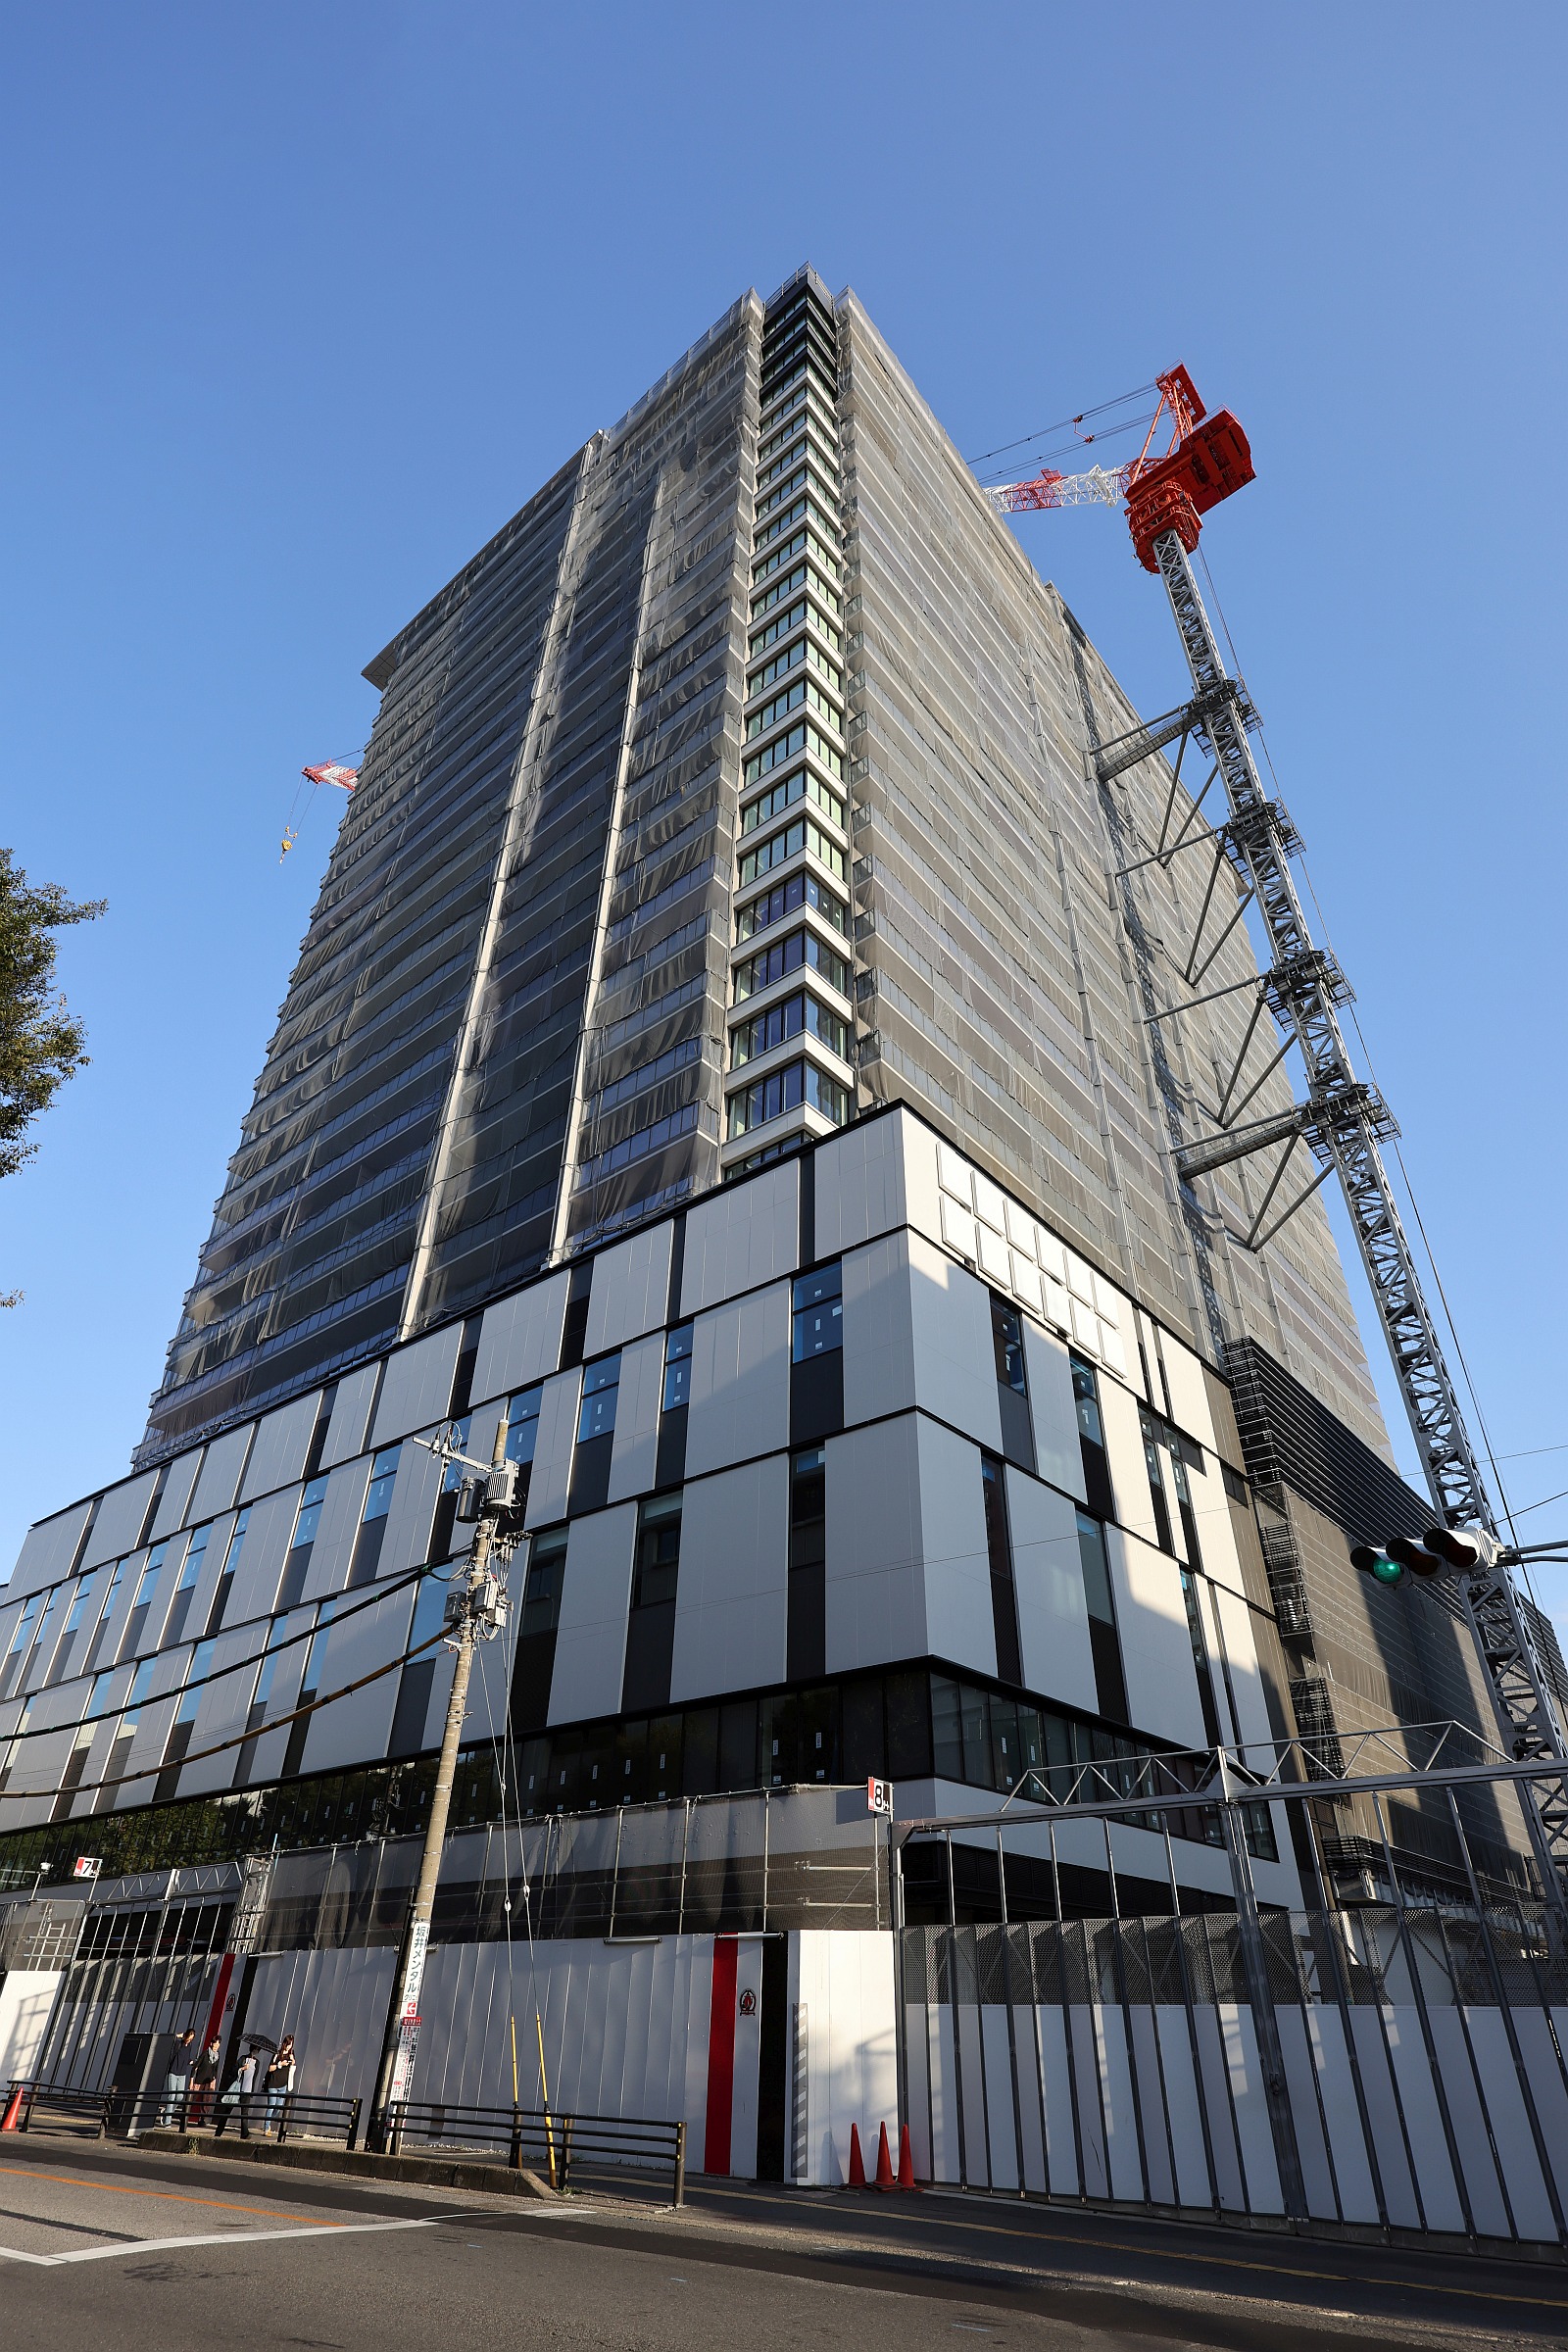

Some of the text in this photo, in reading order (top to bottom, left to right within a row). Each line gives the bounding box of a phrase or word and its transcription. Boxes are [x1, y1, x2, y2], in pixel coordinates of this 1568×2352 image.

[875, 1786, 882, 1807] 8
[82, 1861, 92, 1874] 7
[407, 1926, 426, 1992] 坂井メンタル
